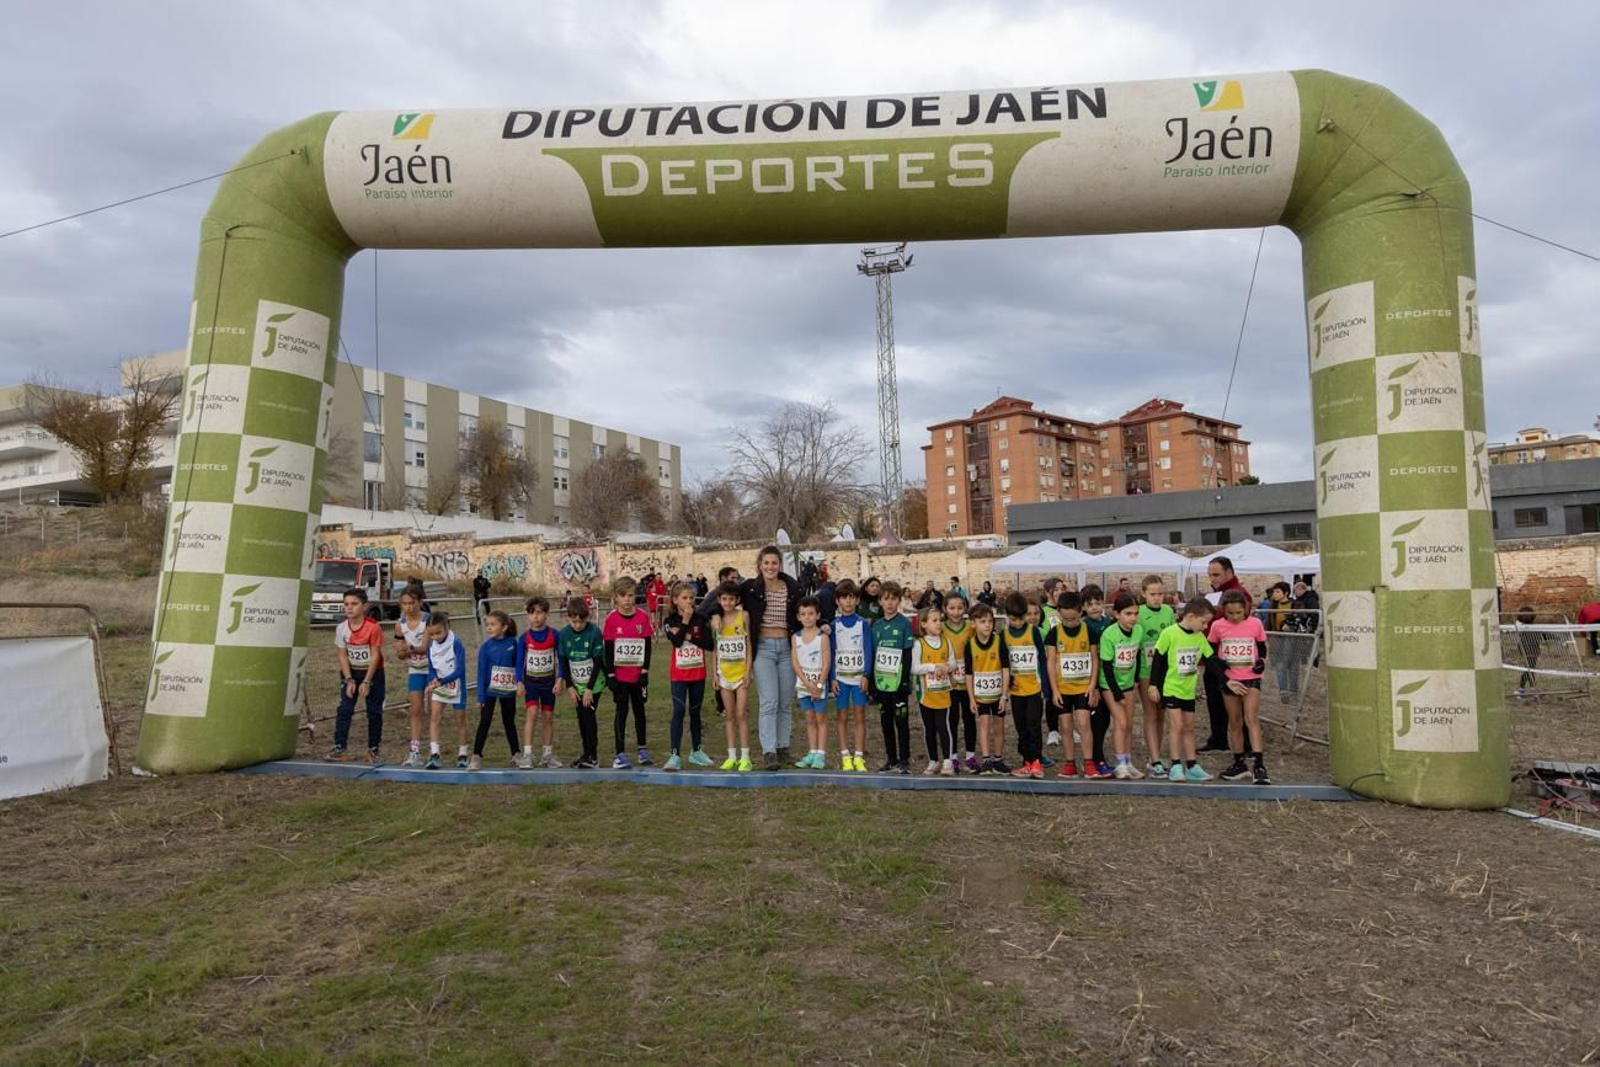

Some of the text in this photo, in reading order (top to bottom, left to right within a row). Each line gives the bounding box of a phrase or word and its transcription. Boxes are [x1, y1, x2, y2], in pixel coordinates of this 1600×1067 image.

[502, 86, 1108, 139] DIPUTACIÓN DE JAÉN
[1164, 115, 1273, 165] Jaén
[361, 144, 453, 186] Jaén
[1218, 163, 1271, 176] interior
[410, 187, 454, 199] interior
[1386, 308, 1452, 321] DEPORTES
[1404, 386, 1457, 397] DIPUTACIÓN
[1404, 398, 1418, 406] DE
[262, 468, 306, 482] DIPUTACIÓN
[1390, 465, 1458, 476] DEPORTES
[260, 476, 273, 485] DE
[1408, 544, 1464, 554] DIPUTACIÓN
[1408, 555, 1422, 564] DE
[244, 607, 290, 617] DIPUTACIÓN
[243, 615, 255, 623] DE
[1393, 625, 1465, 635] DEPORTES
[616, 645, 643, 656] 4322
[719, 642, 744, 653] 4339
[1223, 645, 1253, 657] 4325
[348, 650, 369, 661] 320
[837, 655, 863, 666] 4318
[528, 656, 553, 667] 4334
[1062, 660, 1089, 671] 4331
[572, 666, 592, 678] 328
[976, 678, 1001, 690] 4332
[1413, 706, 1471, 716] DIPUTACIÓN
[1413, 716, 1427, 725] DE
